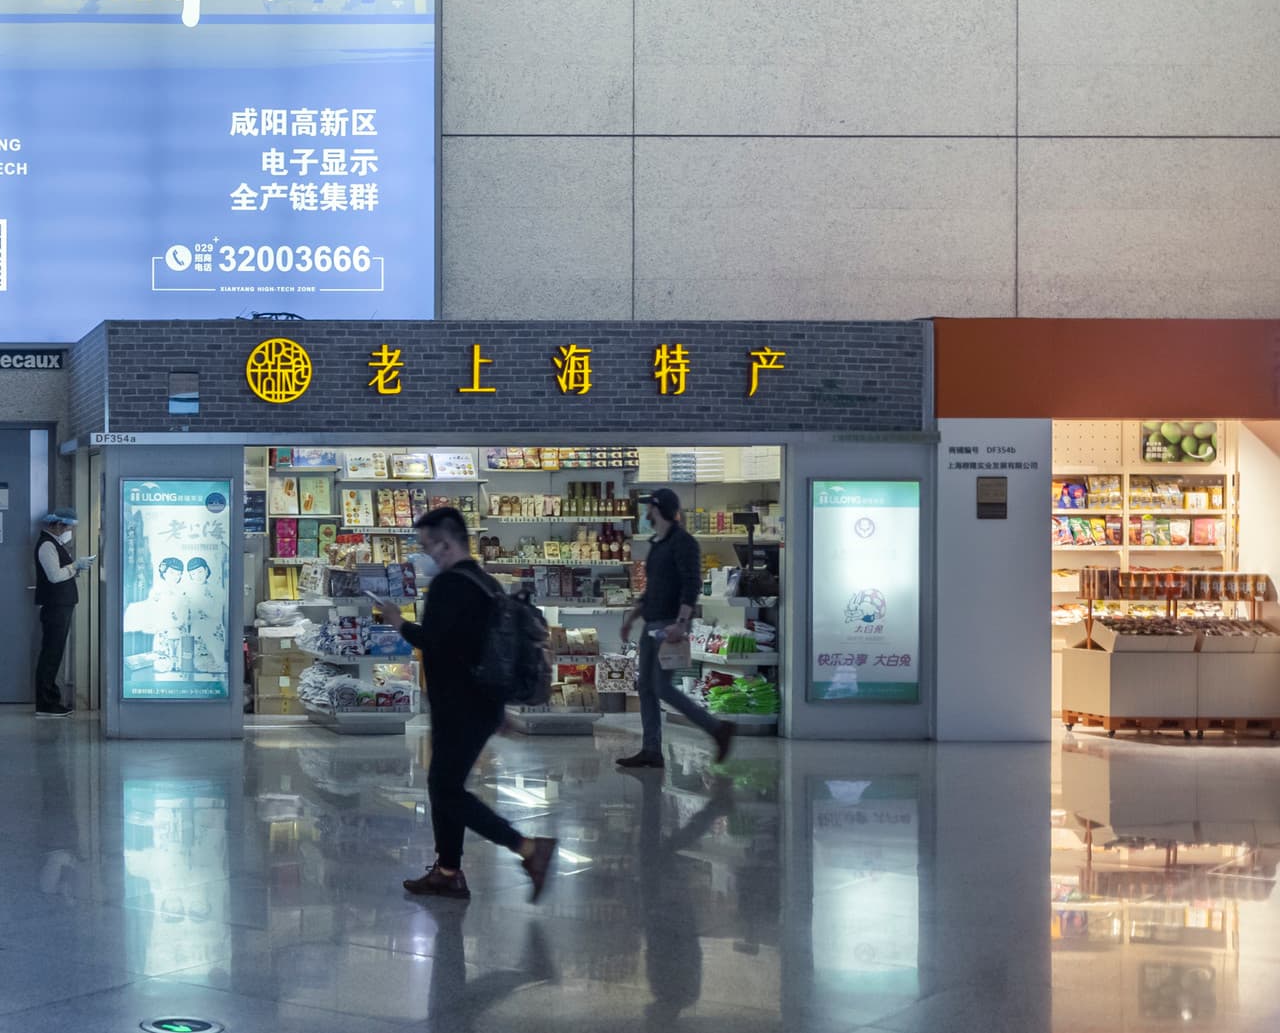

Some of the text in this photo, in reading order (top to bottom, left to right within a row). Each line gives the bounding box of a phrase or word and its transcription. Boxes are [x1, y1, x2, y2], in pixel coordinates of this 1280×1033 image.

[230, 108, 378, 136] 咸阳高新区
[262, 148, 379, 176] 电子显示
[230, 183, 379, 212] 全产链集群
[194, 243, 214, 253] 029
[218, 245, 371, 272] 32003666
[367, 343, 787, 397] 老上海特产
[95, 434, 137, 443] DF354a
[986, 446, 1017, 454] DF354b
[817, 653, 912, 667] 快乐分享 大白兔
